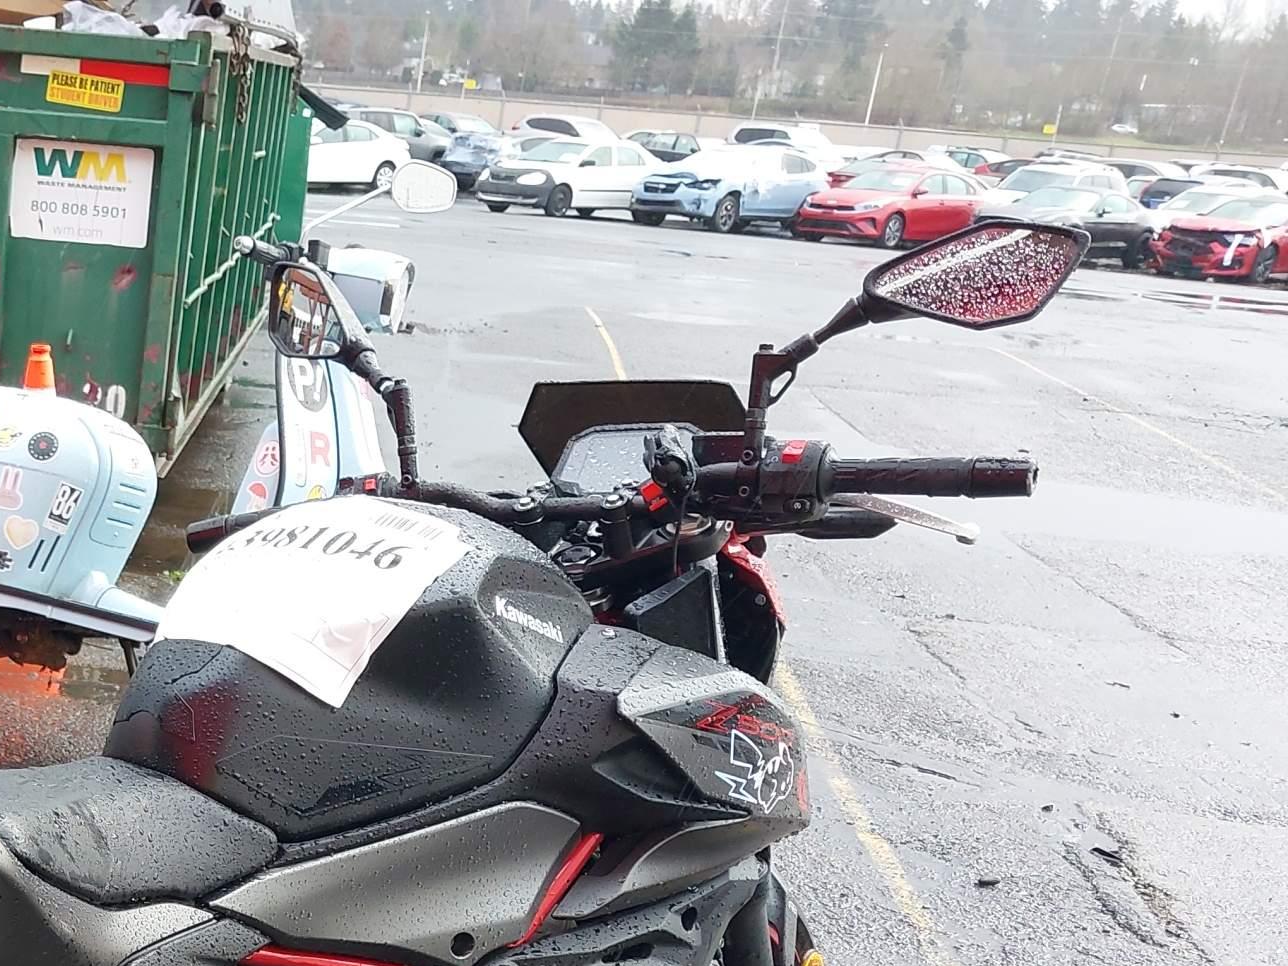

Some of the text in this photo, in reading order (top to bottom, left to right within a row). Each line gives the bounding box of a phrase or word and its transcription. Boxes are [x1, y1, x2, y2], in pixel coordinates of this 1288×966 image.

[52, 73, 121, 96] PLEASE BE PATIENT
[33, 147, 127, 184] WM
[37, 180, 127, 192] WASTE MANAGEMENT
[30, 200, 126, 219] 800 808 5901
[494, 595, 564, 643] Kawasaki
